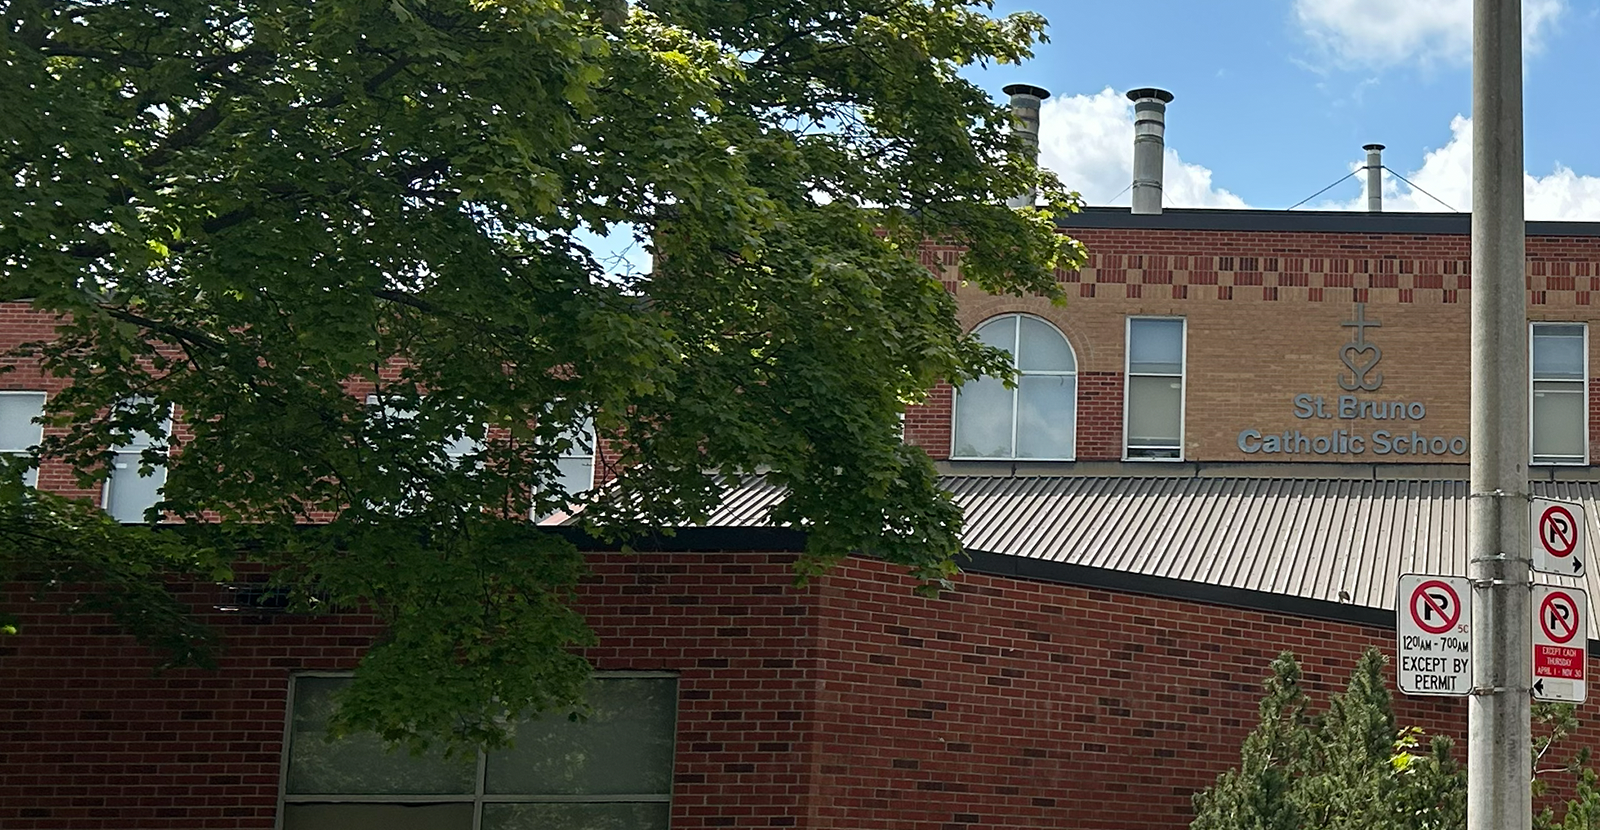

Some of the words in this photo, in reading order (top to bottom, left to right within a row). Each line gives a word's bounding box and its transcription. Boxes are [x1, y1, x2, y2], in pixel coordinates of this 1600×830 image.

[1294, 393, 1333, 419] St.
[1339, 395, 1426, 420] Bruno
[1237, 429, 1365, 454] Catholic
[1372, 430, 1467, 455] Schoo
[1457, 624, 1469, 633] 5C
[1542, 646, 1561, 655] EXCEPT
[1402, 656, 1447, 672] EXCEPT
[1453, 658, 1469, 673] BY
[1546, 656, 1572, 666] THURSDAY
[1537, 666, 1552, 675] APRIL
[1562, 668, 1573, 676] NOV
[1415, 674, 1457, 690] PERMIT
